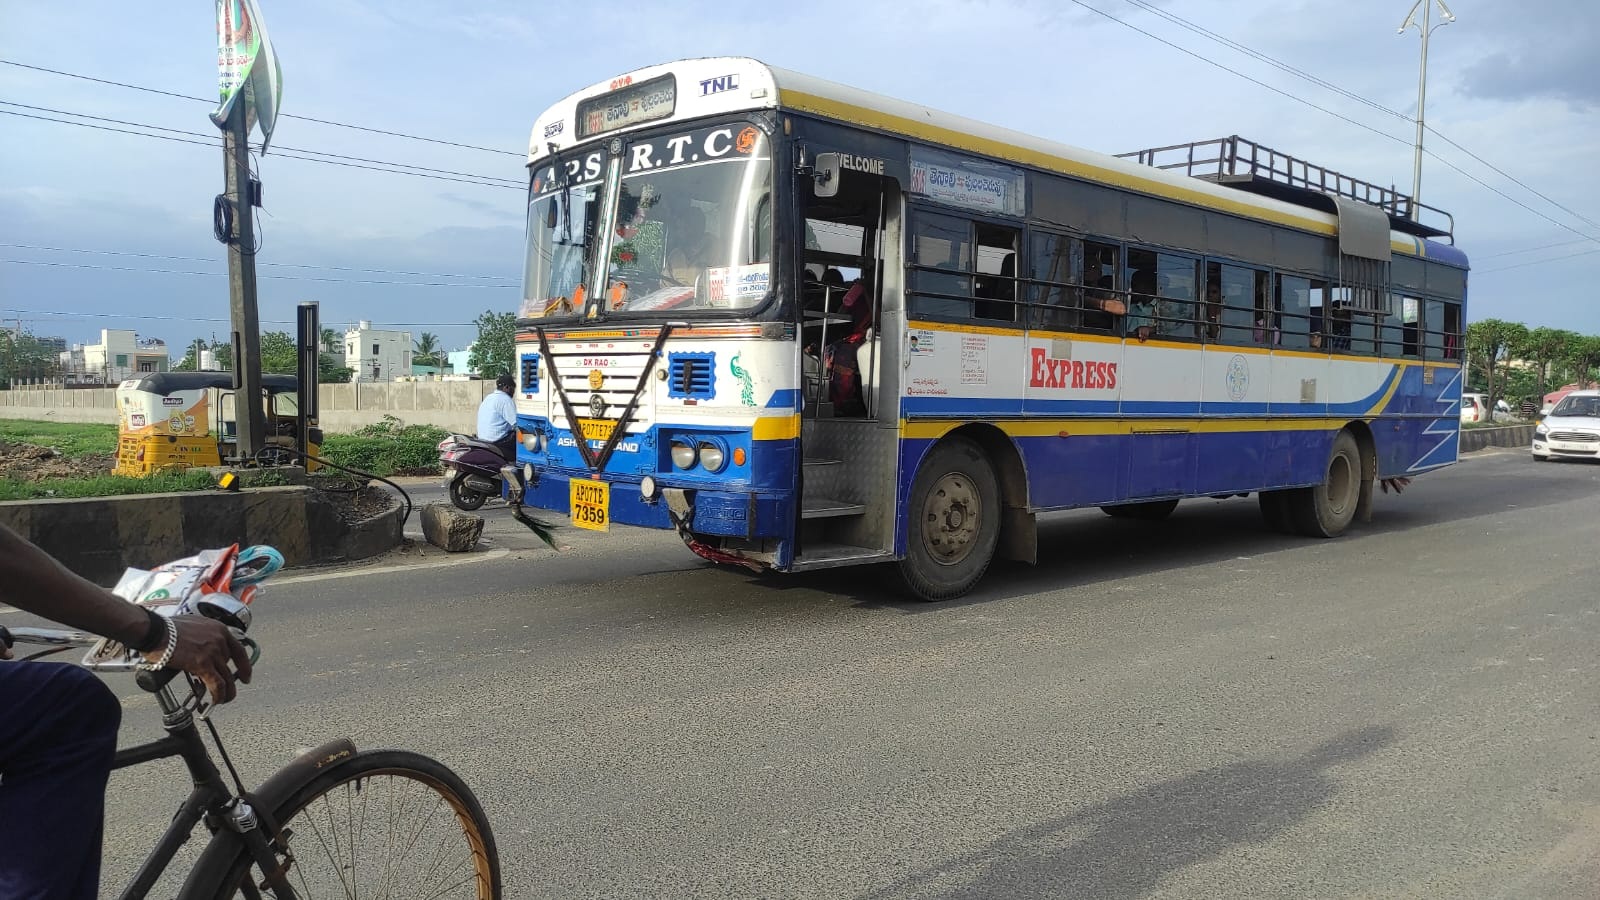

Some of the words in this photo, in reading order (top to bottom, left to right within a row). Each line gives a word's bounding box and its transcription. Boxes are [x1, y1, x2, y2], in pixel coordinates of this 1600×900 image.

[700, 75, 739, 95] TNL
[629, 129, 733, 172] R.T.C
[930, 167, 956, 188] తెనాలి
[1030, 347, 1117, 389] EXPRESS
[576, 485, 603, 504] AP07TE
[575, 504, 605, 523] 7359
